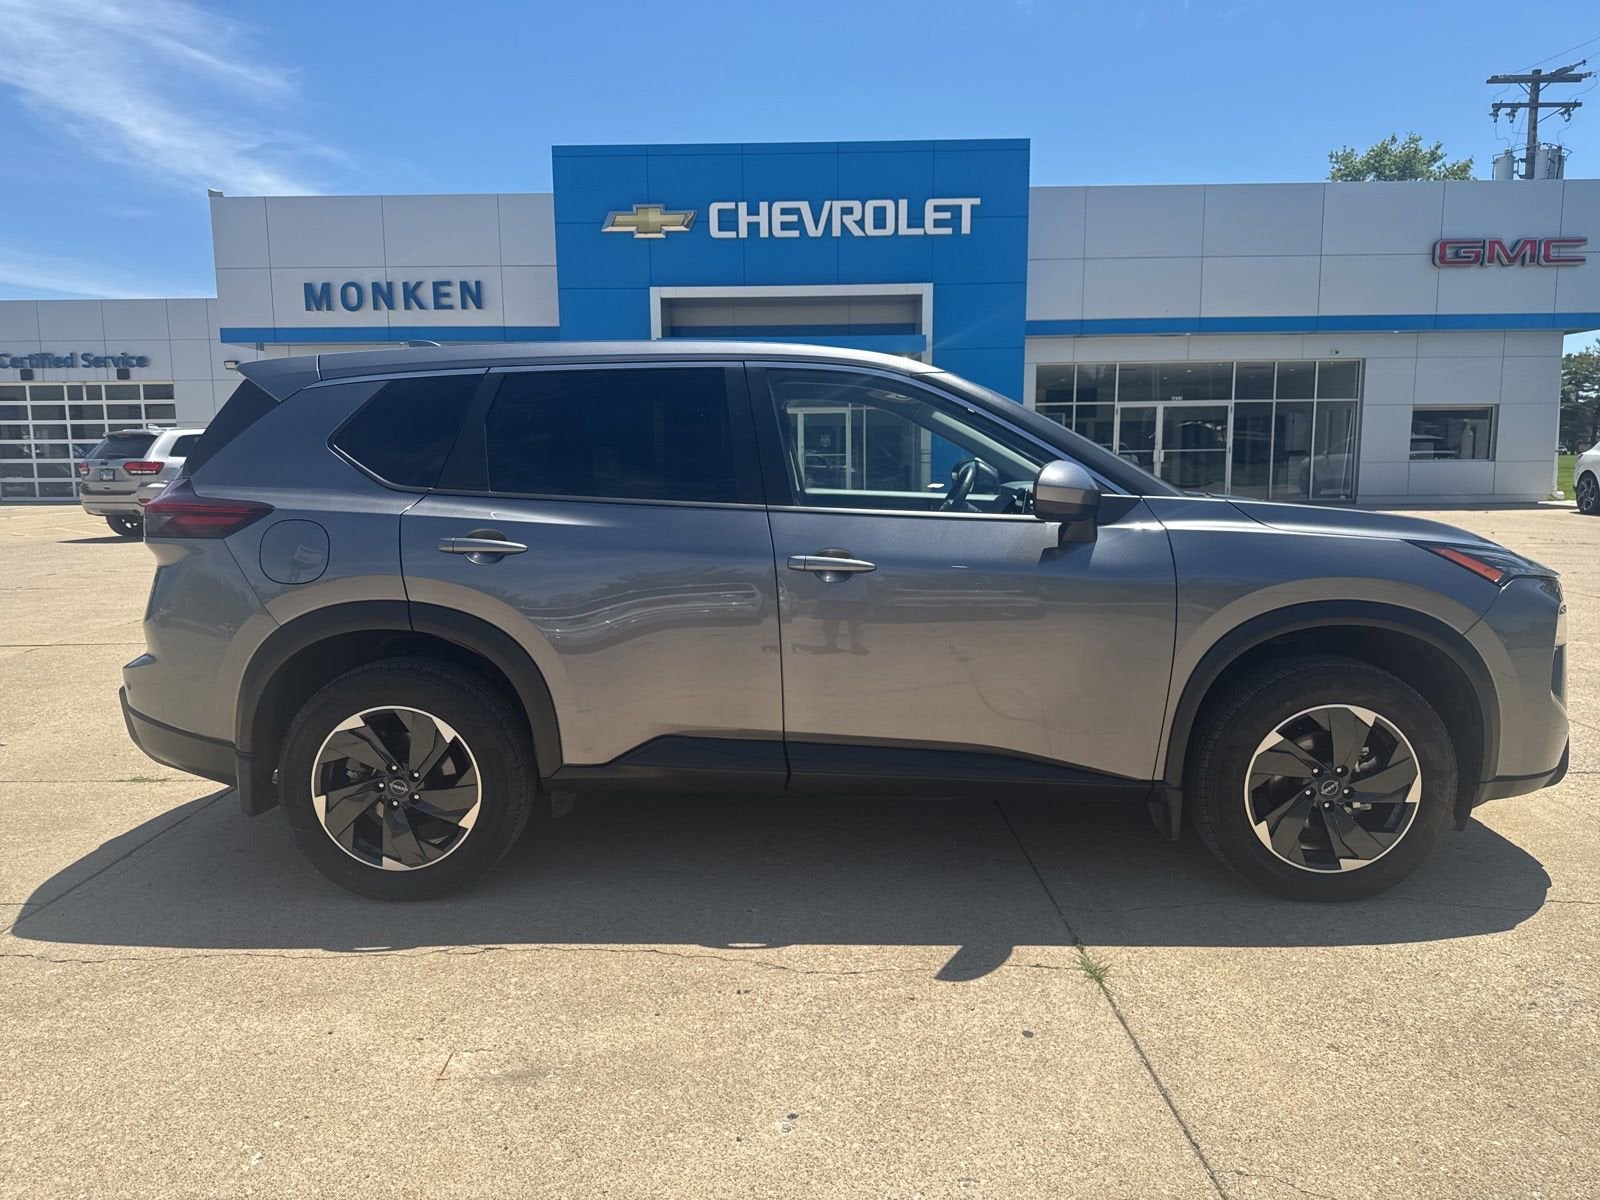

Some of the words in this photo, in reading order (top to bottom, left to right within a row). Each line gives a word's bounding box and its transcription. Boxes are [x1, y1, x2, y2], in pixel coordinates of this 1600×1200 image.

[708, 197, 981, 238] CHEVROLET
[1432, 237, 1588, 267] GMC
[303, 280, 484, 312] MONKEN
[0, 352, 76, 369] Certified
[80, 352, 149, 369] Service
